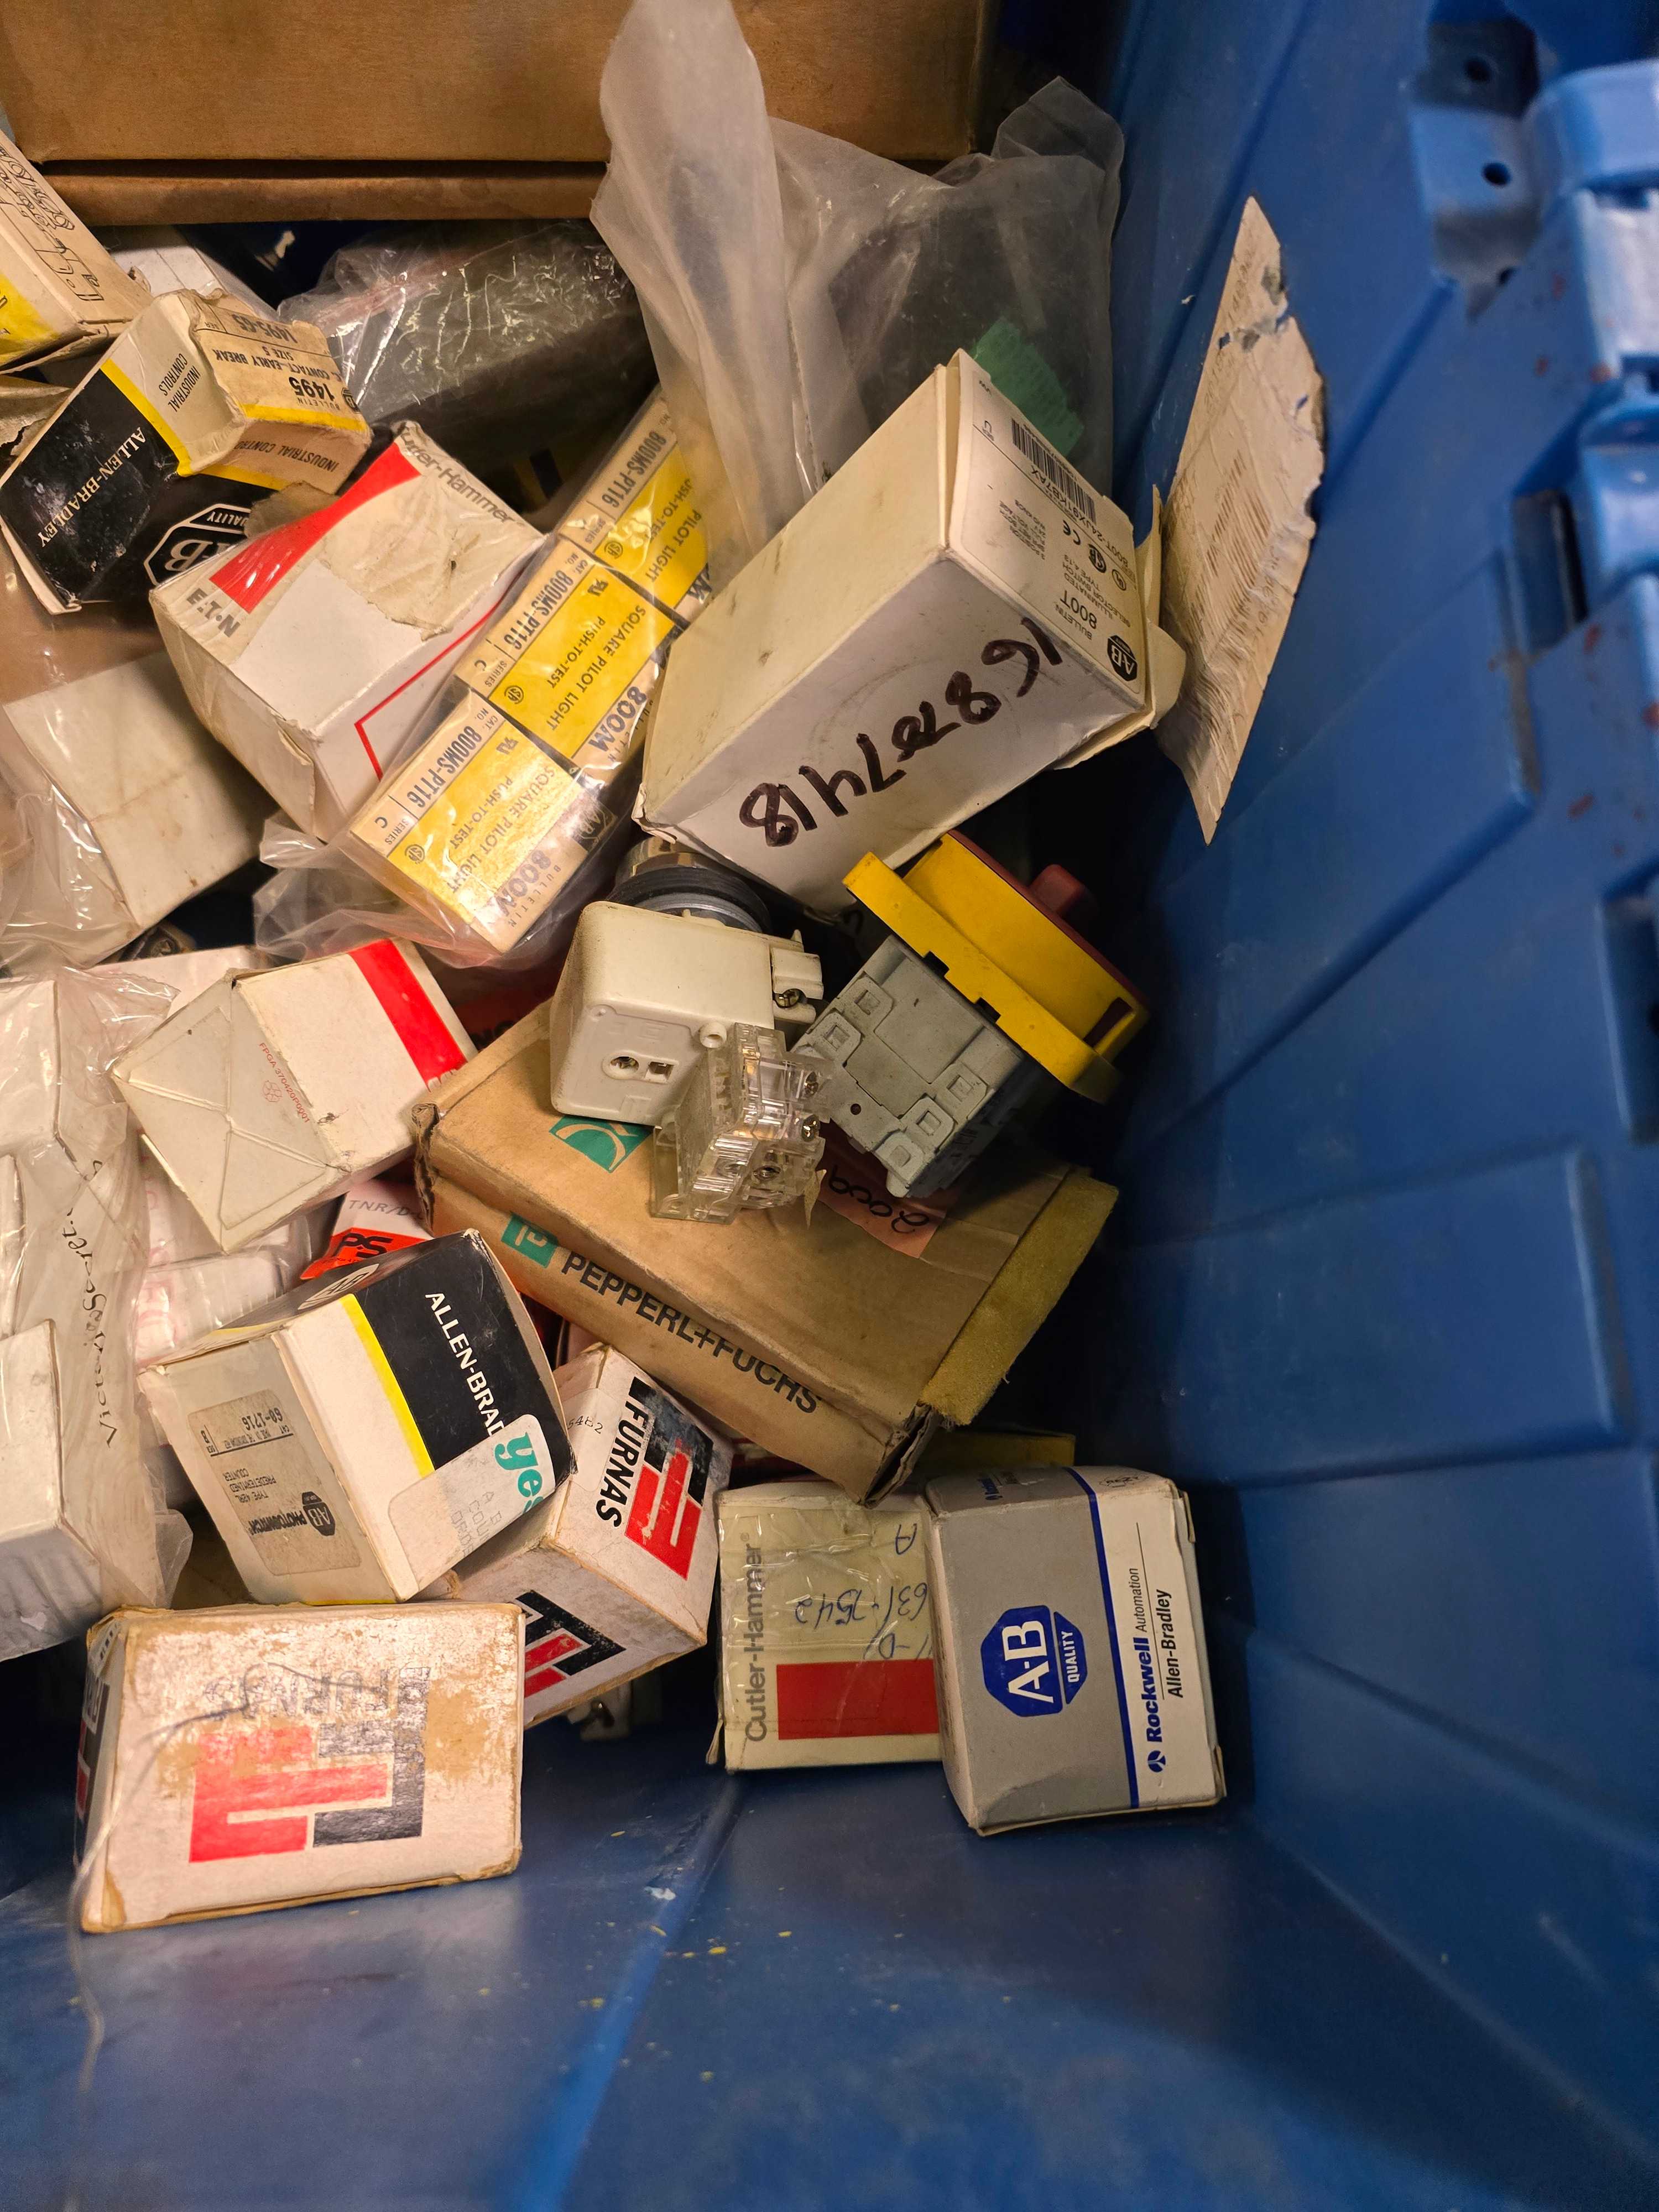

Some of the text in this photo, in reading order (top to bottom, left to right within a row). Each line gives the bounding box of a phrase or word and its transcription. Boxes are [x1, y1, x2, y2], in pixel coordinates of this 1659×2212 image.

[212, 349, 247, 364] BREAK
[251, 356, 282, 369] EARLY
[262, 346, 293, 360] SIZE 5
[158, 352, 187, 396] CONTROLS
[288, 363, 329, 378] CONTACT
[168, 364, 201, 413] INDUSTRIAL
[288, 377, 334, 399] 1495
[297, 397, 340, 409] BULLETIN
[984, 418, 992, 434] U
[277, 445, 338, 472] INDUSTRIAL
[601, 429, 668, 508] 800MS-PT16
[37, 426, 145, 547] ALLEN-BRADLEY
[206, 510, 248, 526] UALITY
[584, 517, 608, 545] SERIES
[1062, 519, 1081, 549] CE
[644, 508, 703, 582] PILOT LIGHT
[572, 559, 589, 576] CAT.
[1062, 560, 1091, 593] SWITCH
[502, 552, 580, 651] NO. 800MS-PT16
[1060, 588, 1097, 632] 800T
[1063, 570, 1112, 620] ILLUMINATED
[1093, 587, 1130, 628] SELECTOR
[1054, 600, 1092, 641] BULLETIN
[473, 656, 489, 672] C
[544, 603, 648, 731] SQUARE PILOT LIGHT
[545, 615, 607, 688] PUSH-TO-TEST
[483, 659, 509, 687] SERIES
[481, 713, 500, 732] CAT.
[587, 684, 649, 754] 800M
[405, 707, 490, 809] NO. 800MS-PT16
[374, 814, 390, 829] C
[444, 763, 556, 894] SQUARE PILOT LIGHT
[447, 775, 514, 850] PUSH-TO-TEST
[383, 817, 410, 846] SERIES
[507, 864, 561, 930] BULLETIN
[259, 1042, 276, 1068] FPGA
[561, 1251, 823, 1416] PEPPERL+FUCHS
[200, 1430, 209, 1443] B
[279, 1424, 290, 1433] CAT
[222, 1468, 249, 1481] COUNTER
[596, 1401, 648, 1527] FURNAS
[228, 1474, 276, 1493] PREDETERMINED
[251, 1489, 268, 1500] TYPE
[894, 1522, 917, 1556] A
[1060, 1630, 1081, 1683] QUALITY
[1126, 1567, 1162, 1743] Rockwell Automation
[1152, 1589, 1183, 1697] Allen-Bradley
